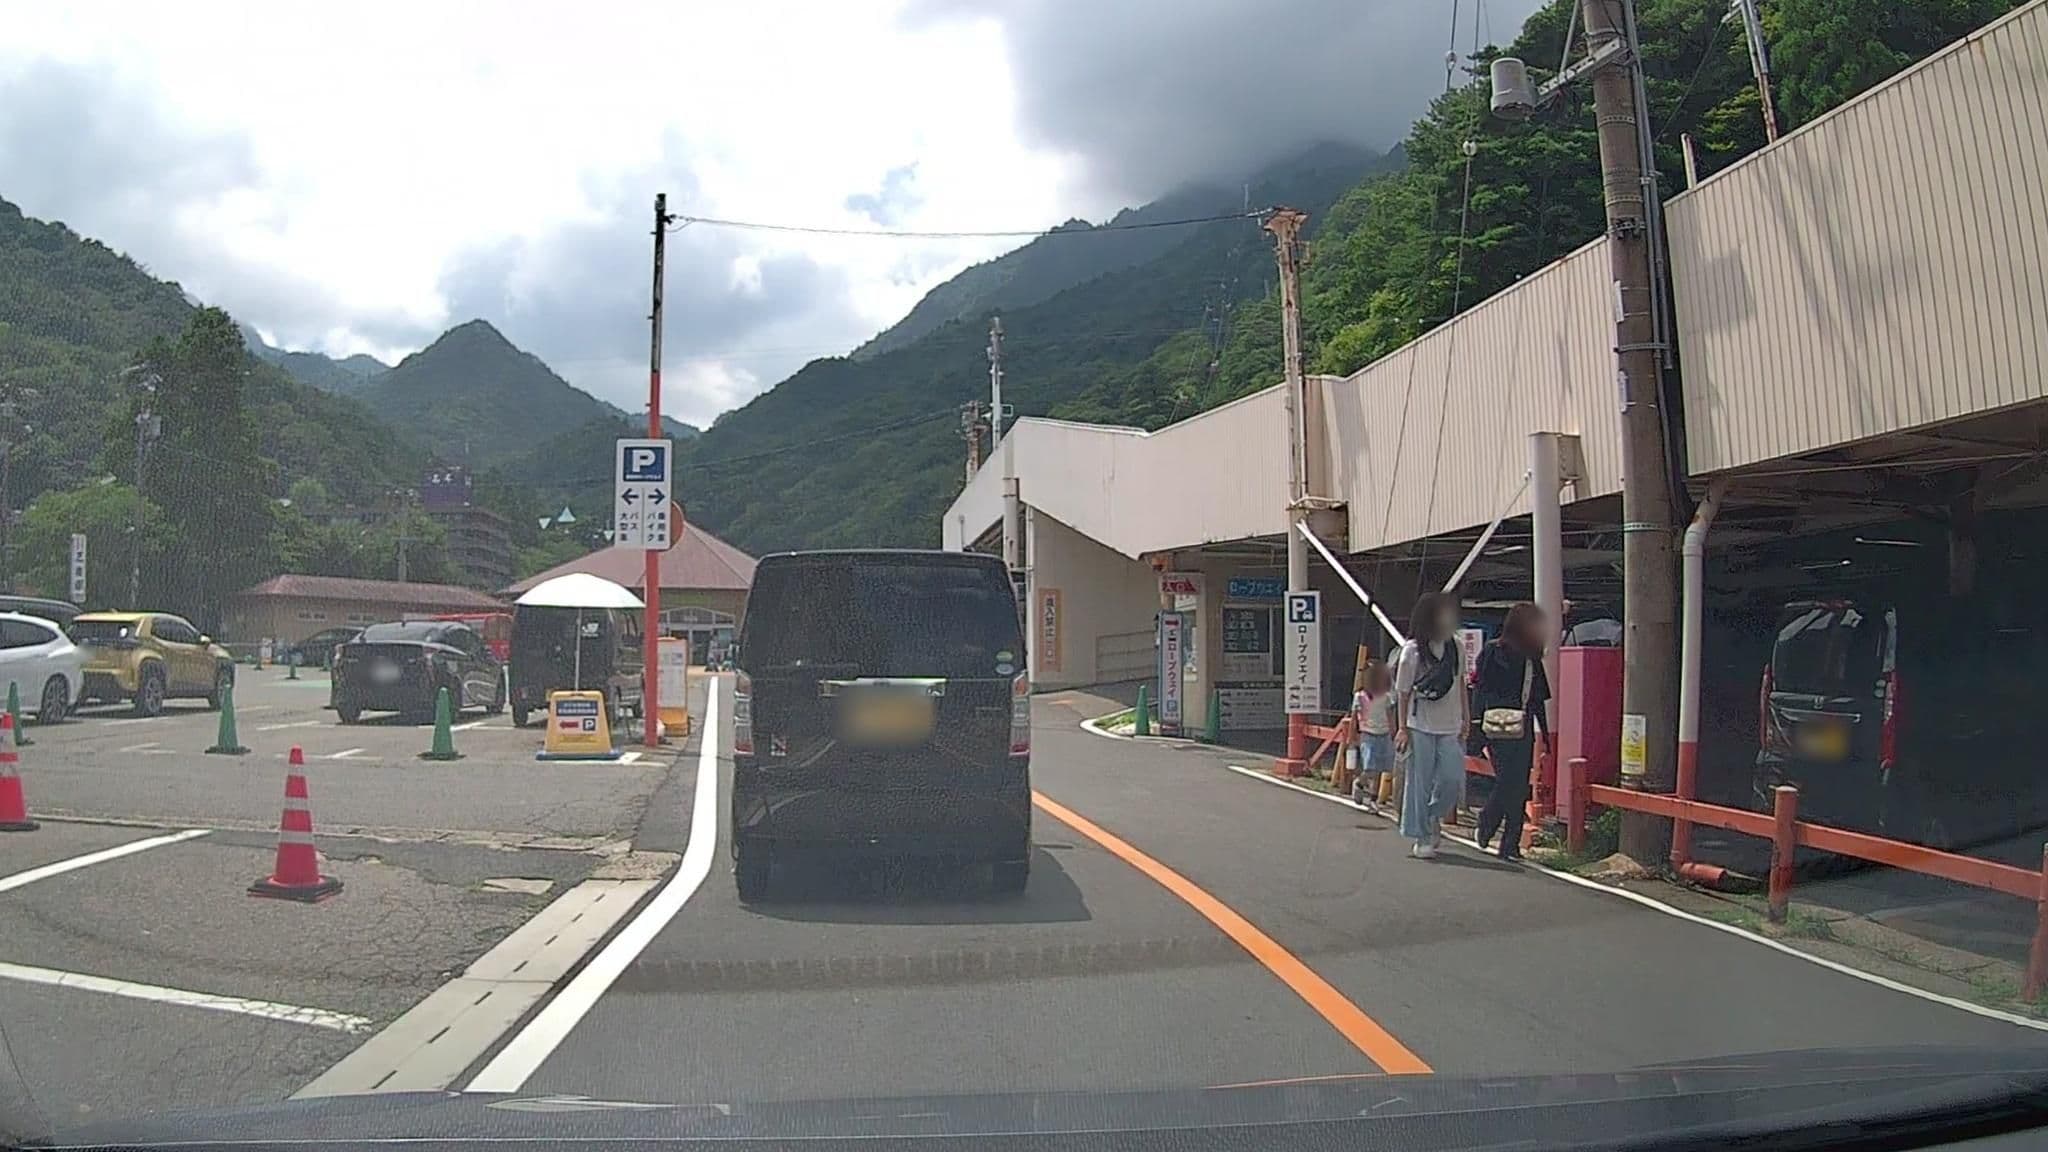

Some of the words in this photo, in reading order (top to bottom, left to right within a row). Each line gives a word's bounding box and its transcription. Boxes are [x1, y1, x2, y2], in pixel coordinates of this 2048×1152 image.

[632, 449, 656, 473] P
[630, 512, 639, 530] バス
[647, 512, 656, 542] バイク
[1291, 598, 1307, 621] P
[585, 719, 595, 729] P
